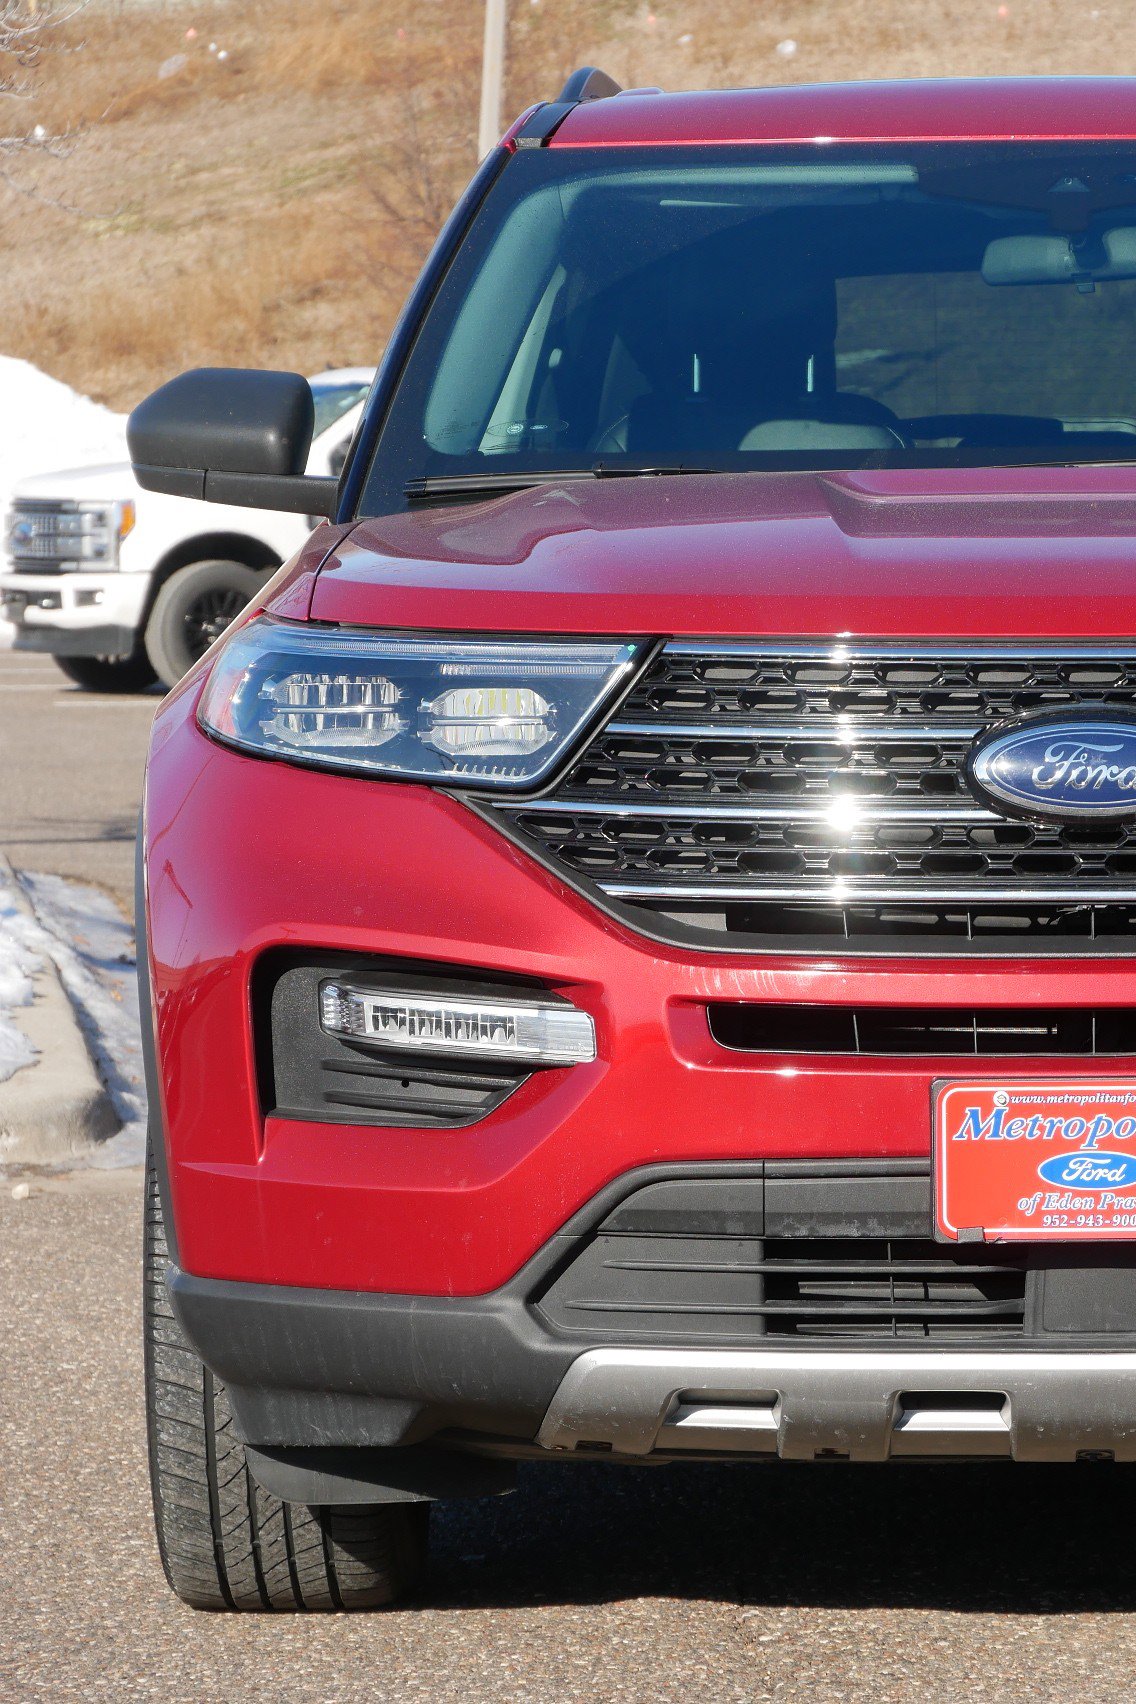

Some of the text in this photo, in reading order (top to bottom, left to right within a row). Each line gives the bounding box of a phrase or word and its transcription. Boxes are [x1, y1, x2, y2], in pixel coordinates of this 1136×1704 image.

[1061, 1157, 1127, 1182] Ford
[1018, 1192, 1042, 1216] of
[1042, 1192, 1095, 1210] Eden
